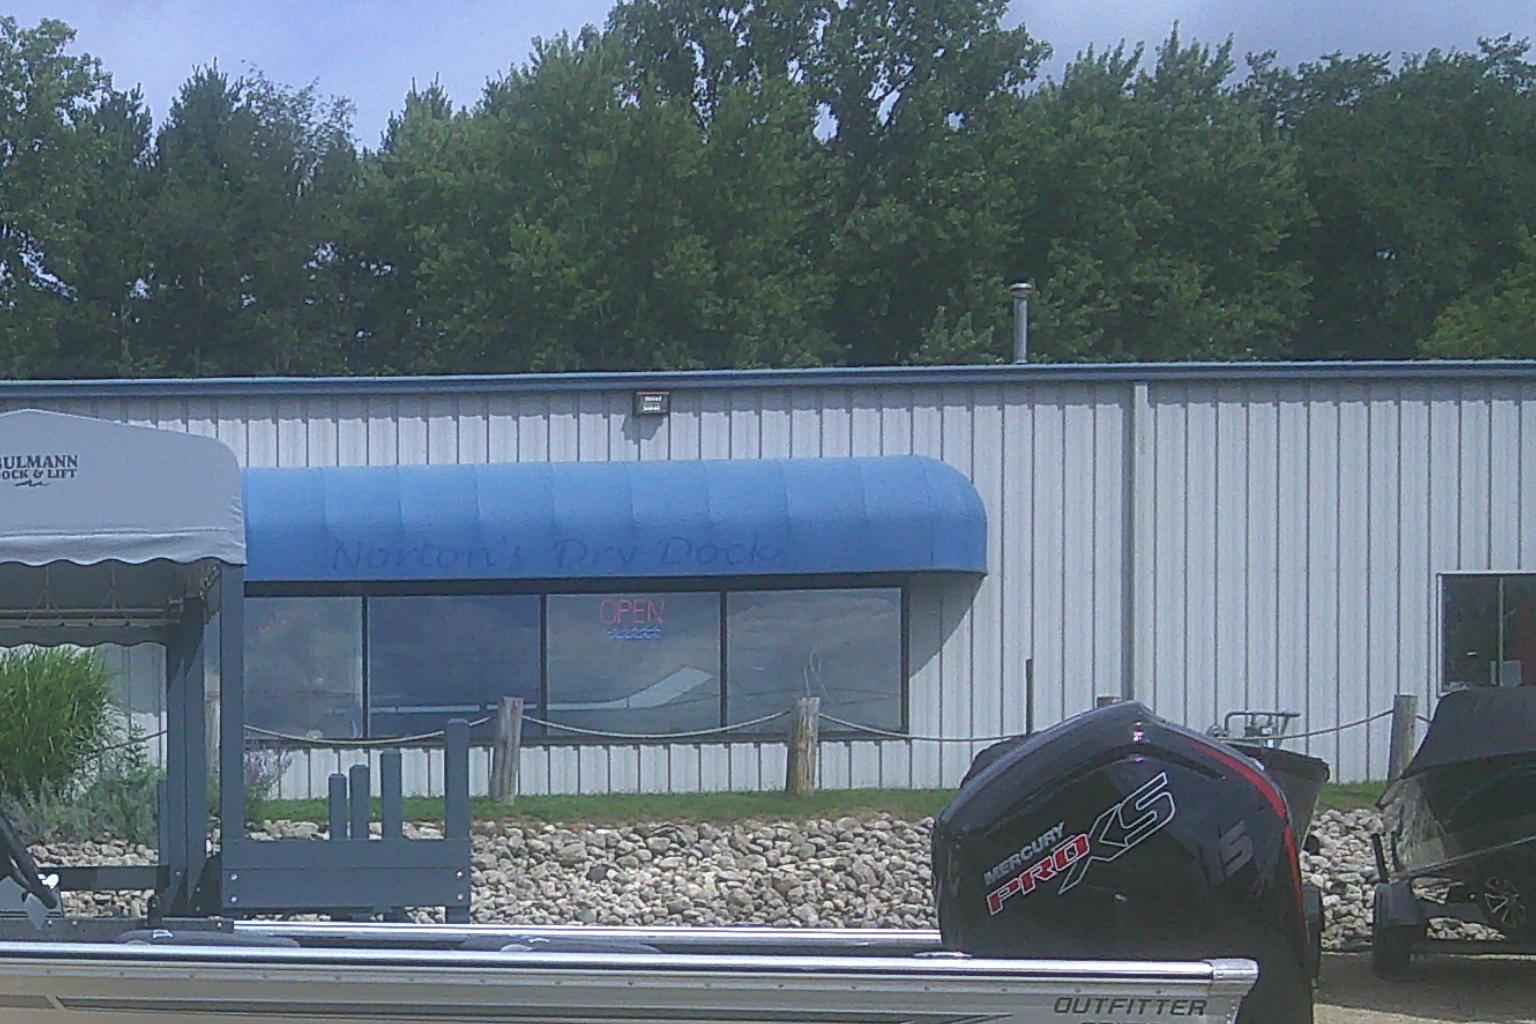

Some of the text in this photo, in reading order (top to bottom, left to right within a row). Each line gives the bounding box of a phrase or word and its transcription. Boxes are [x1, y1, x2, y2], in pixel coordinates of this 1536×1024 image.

[33, 469, 44, 479] &
[47, 468, 77, 479] LIFT
[331, 534, 782, 572] Norton's Dry Dock
[600, 599, 665, 625] OPEN
[983, 821, 1065, 887] MERCURY
[986, 772, 1176, 916] PRO XS
[1054, 997, 1208, 1016] OUTFITTER
